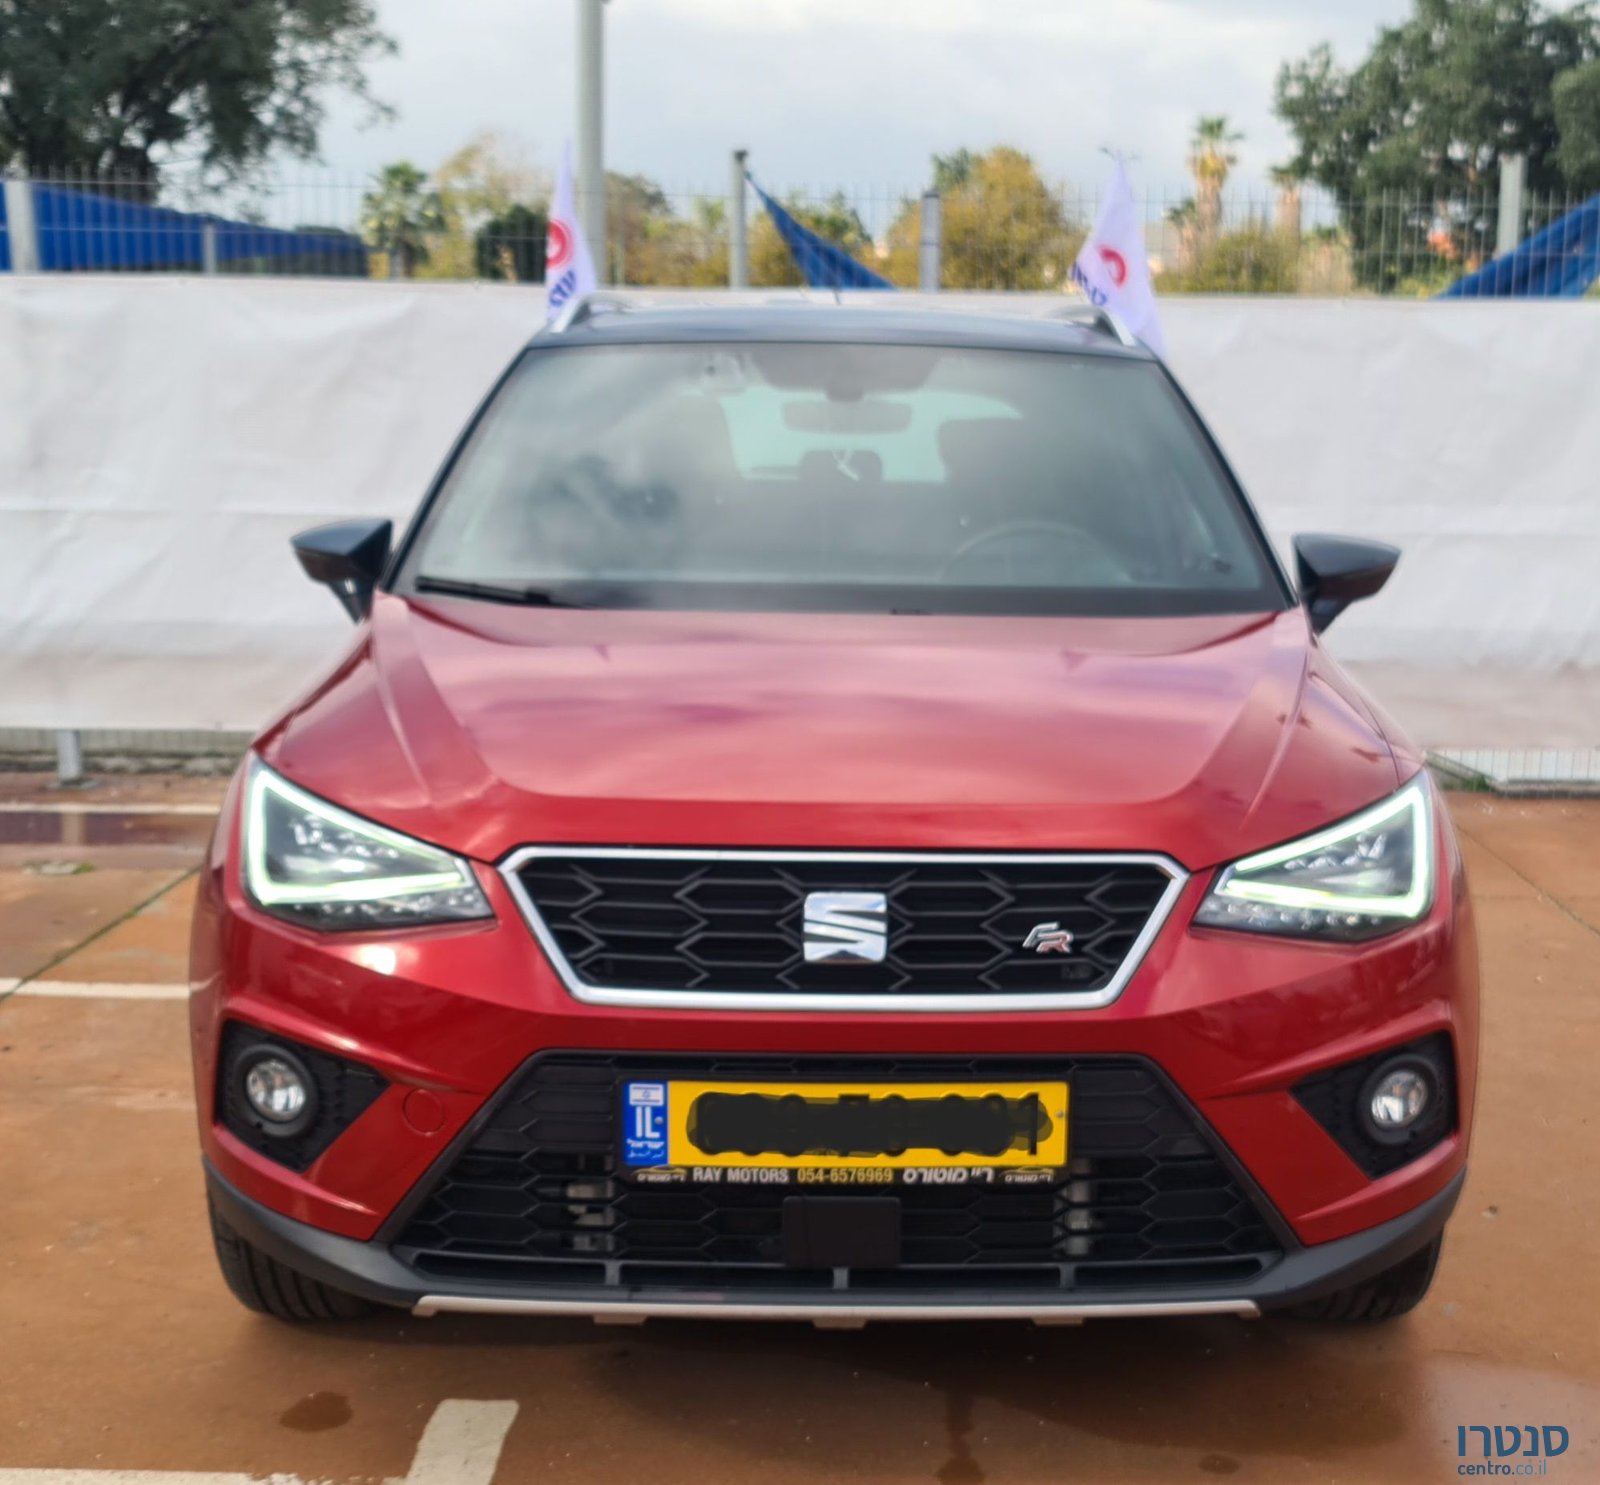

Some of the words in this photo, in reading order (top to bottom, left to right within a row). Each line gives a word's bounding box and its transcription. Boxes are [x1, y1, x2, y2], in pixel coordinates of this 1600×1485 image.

[636, 1106, 660, 1138] IL
[693, 1167, 722, 1182] RAY
[727, 1168, 789, 1183] MOTORS
[797, 1168, 894, 1183] 054-6576969
[902, 1167, 968, 1184] מוטורס
